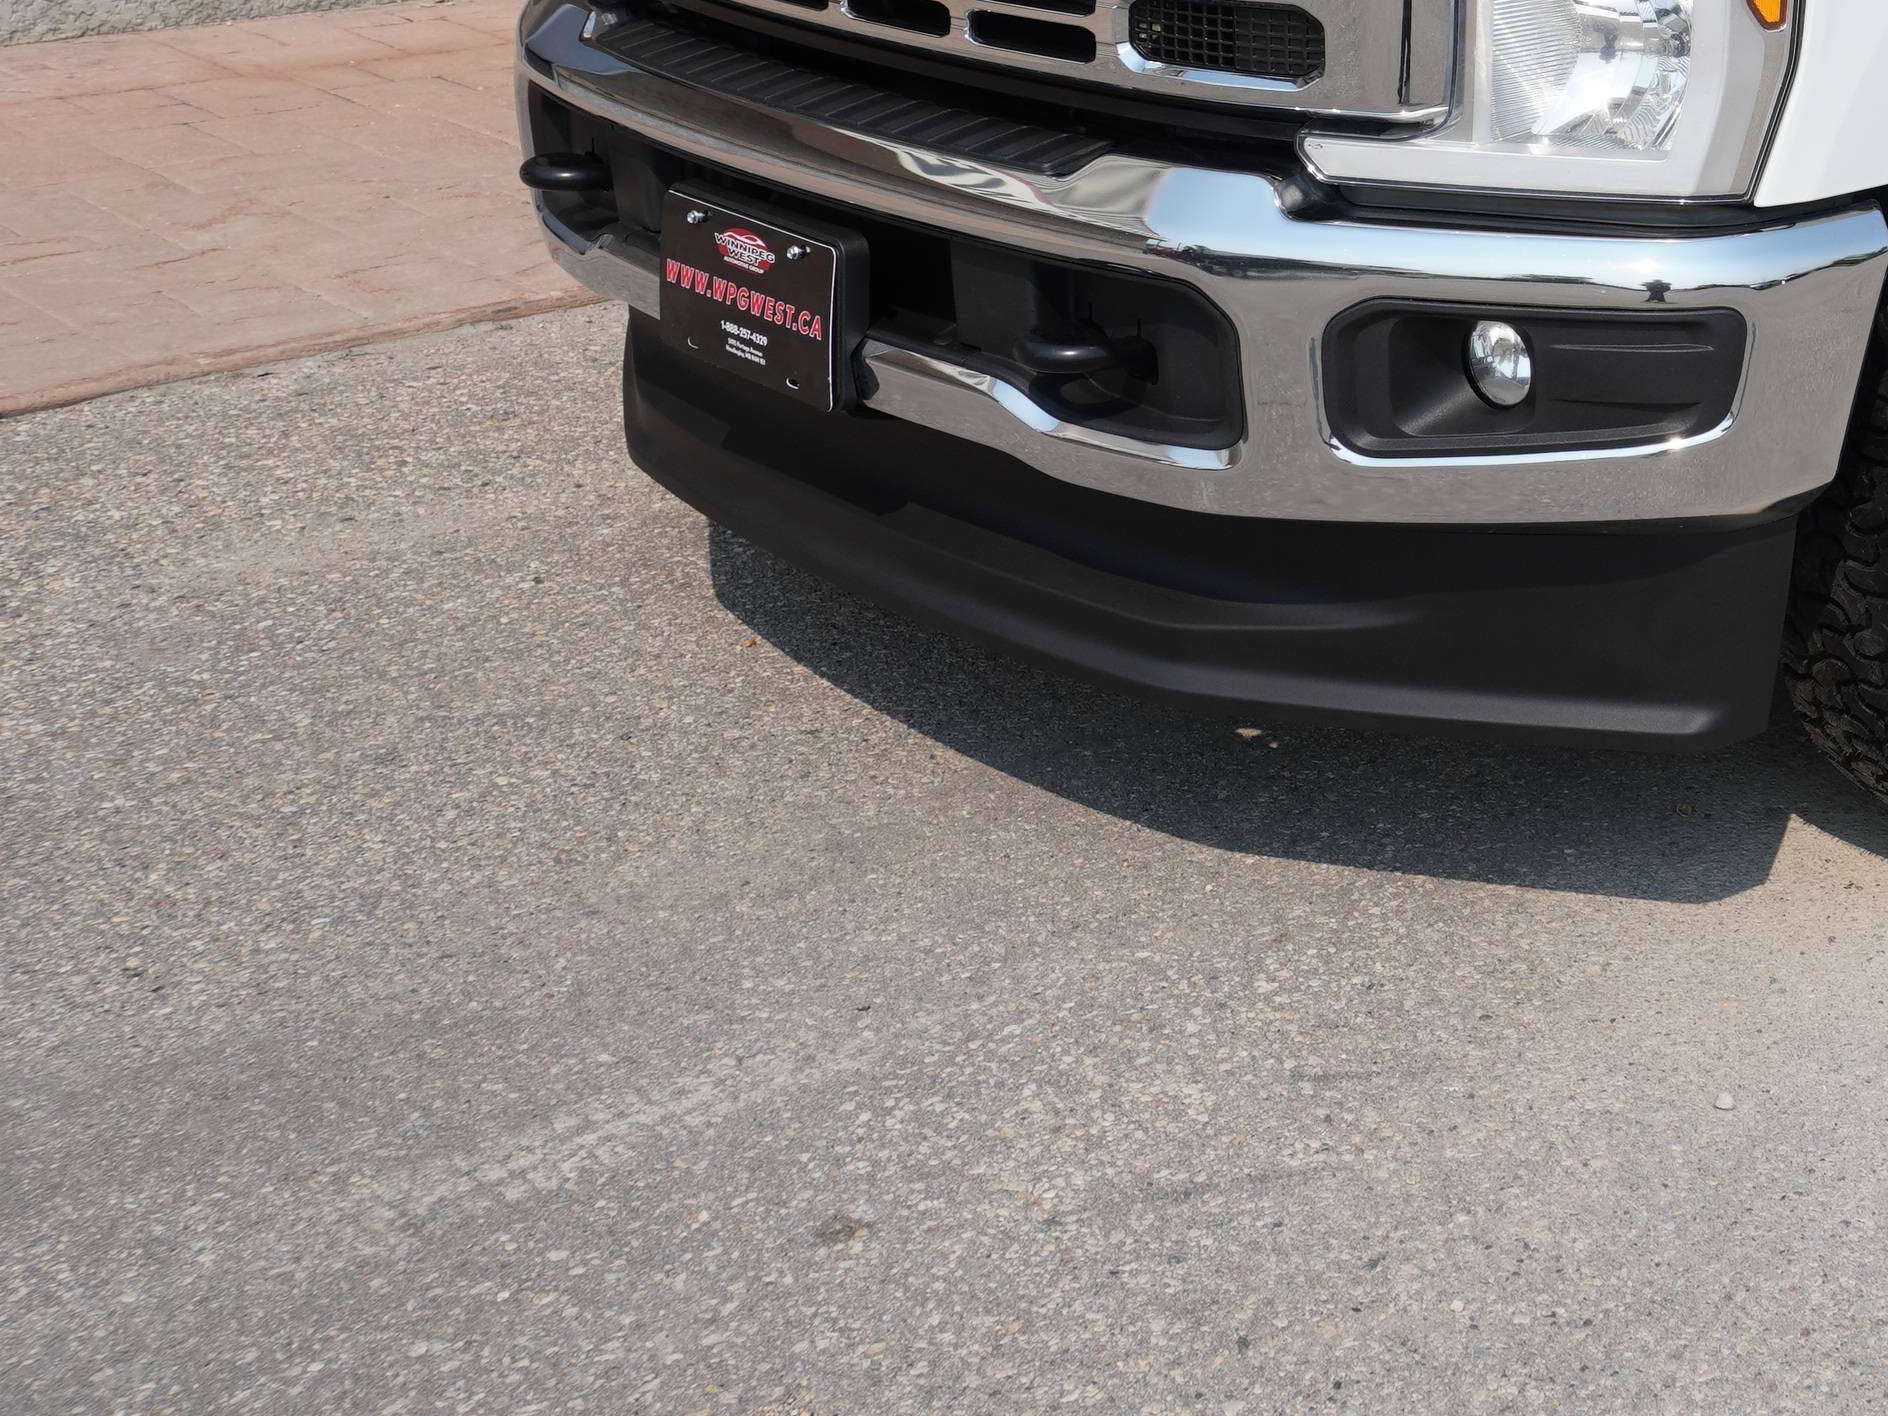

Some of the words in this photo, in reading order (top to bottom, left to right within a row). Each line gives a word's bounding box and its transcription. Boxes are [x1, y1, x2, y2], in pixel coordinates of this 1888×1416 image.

[714, 232, 776, 264] WINNIPEG
[728, 248, 761, 267] WEST
[665, 258, 823, 341] WWW.WPGWEST.CA
